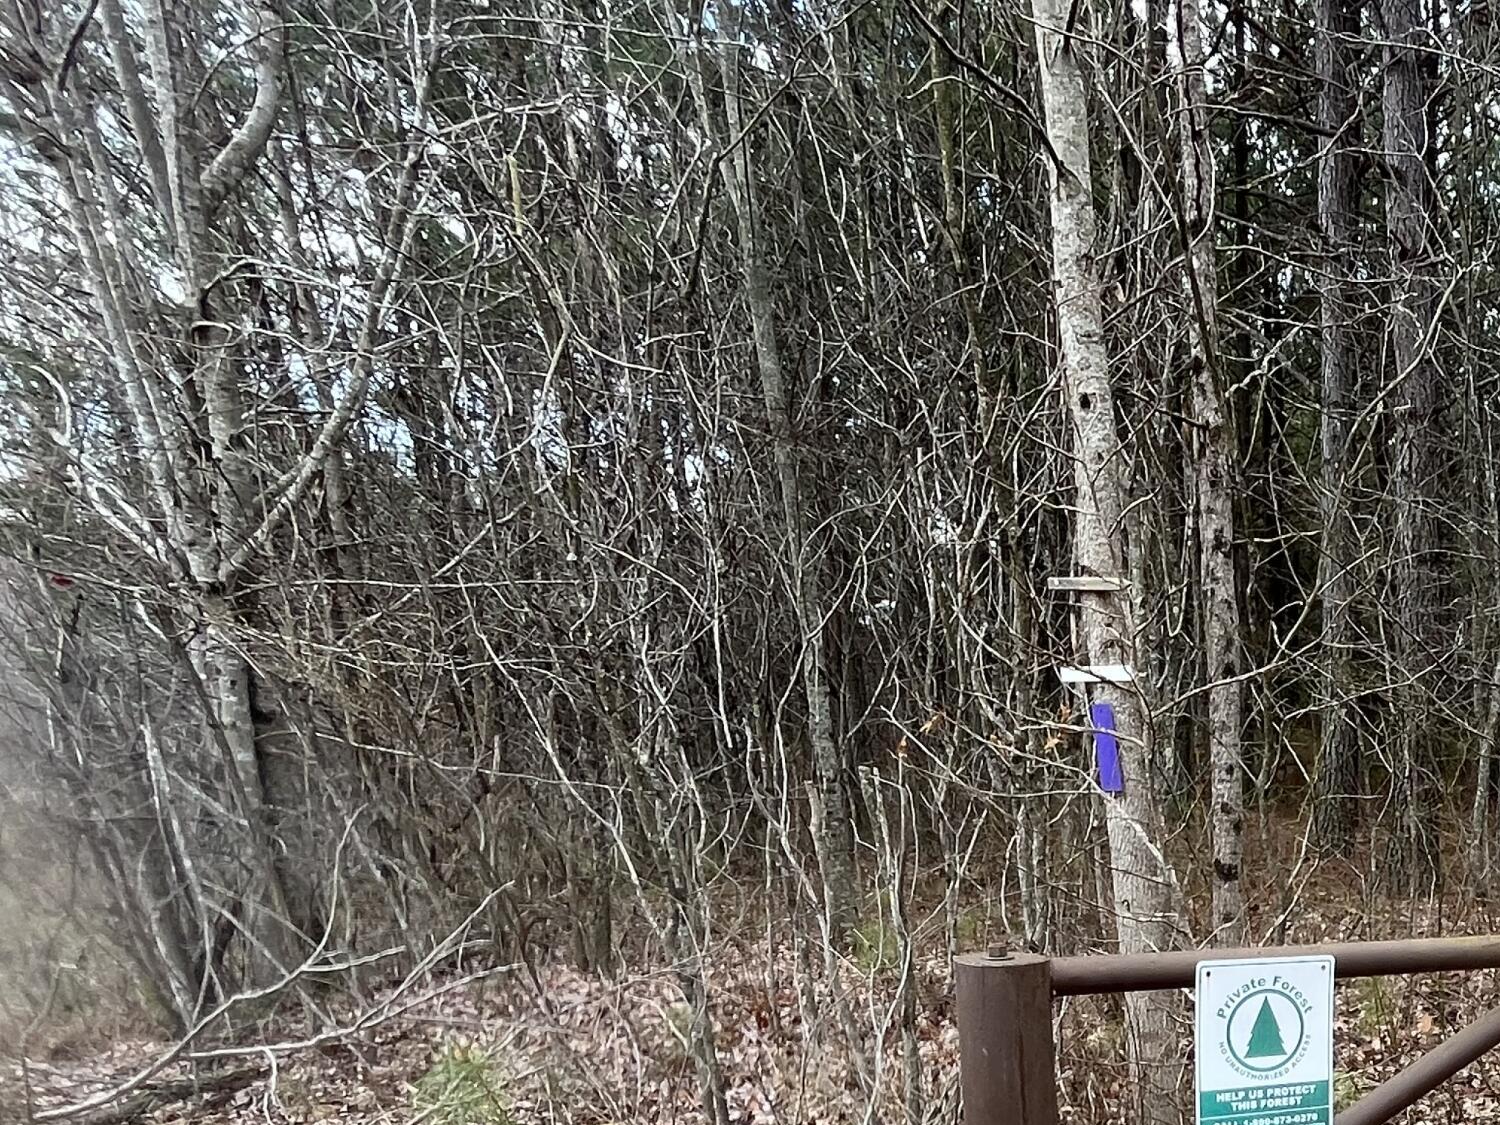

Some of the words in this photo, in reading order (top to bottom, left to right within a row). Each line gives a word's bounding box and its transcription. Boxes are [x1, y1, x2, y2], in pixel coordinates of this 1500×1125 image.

[1216, 977, 1266, 1019] Private
[1272, 976, 1313, 1014] Forest
[1219, 1041, 1228, 1055] NO
[1225, 1056, 1290, 1080] UNAUTHORIZED
[1291, 1034, 1311, 1068] ACCESS
[1216, 1090, 1245, 1102] HELP
[1248, 1089, 1264, 1099] US
[1267, 1085, 1316, 1098] PROTECT
[1231, 1101, 1257, 1111] THIS
[1259, 1096, 1303, 1109] FOREST
